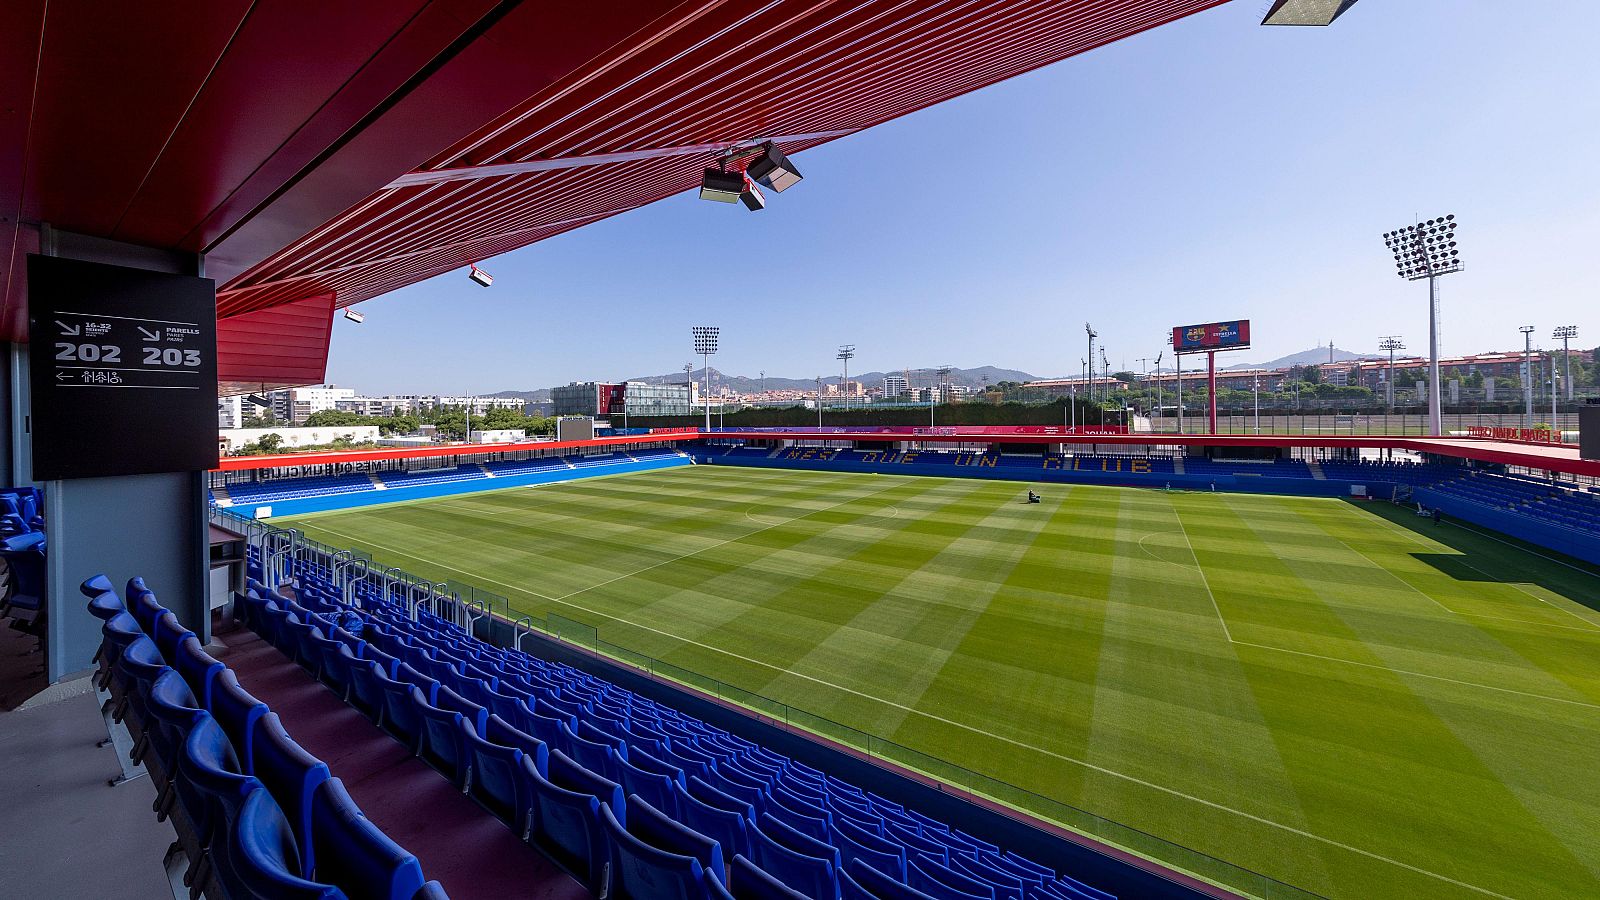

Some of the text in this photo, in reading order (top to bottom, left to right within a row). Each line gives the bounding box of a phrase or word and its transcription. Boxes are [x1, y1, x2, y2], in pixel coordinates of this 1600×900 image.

[55, 342, 121, 363] 202
[142, 347, 201, 367] 203
[954, 455, 998, 467] UN
[1042, 457, 1152, 473] CLUB
